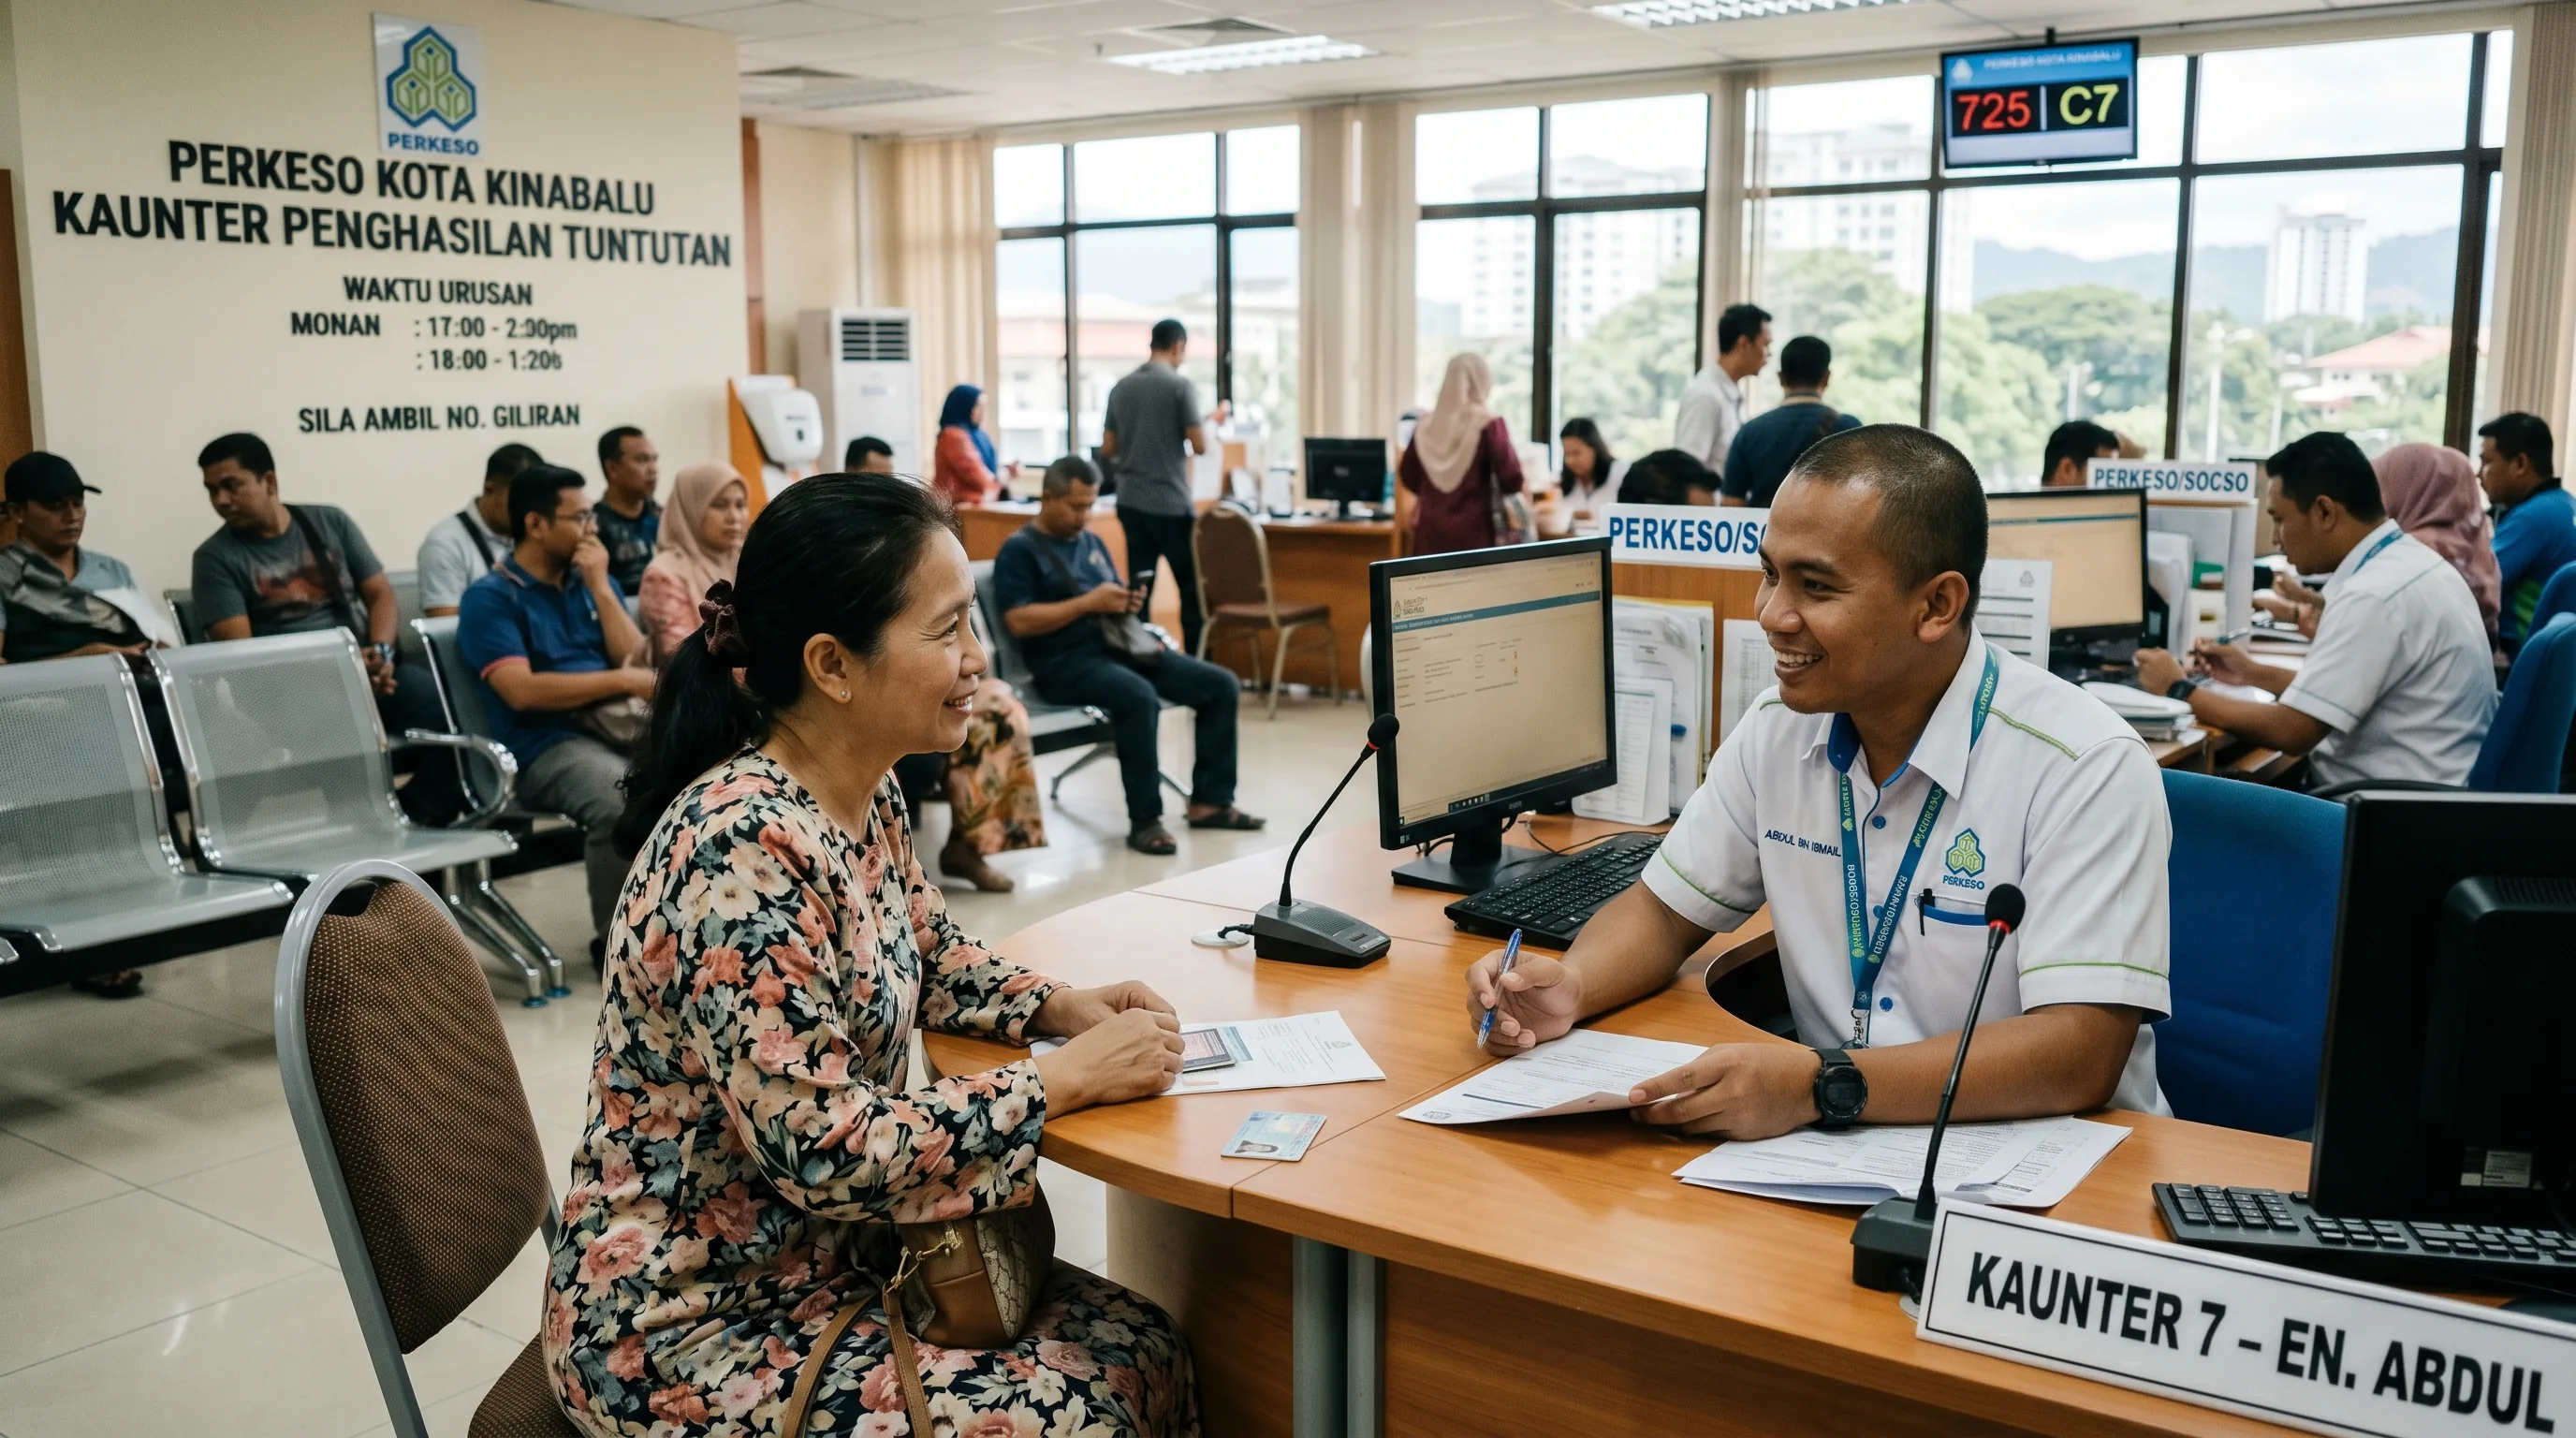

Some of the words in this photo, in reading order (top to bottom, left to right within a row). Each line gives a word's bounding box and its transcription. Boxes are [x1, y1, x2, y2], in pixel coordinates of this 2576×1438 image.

[1957, 90, 2032, 131] 725
[2059, 83, 2119, 125] C7
[388, 132, 479, 155] PERKESO
[168, 140, 364, 195] PERKESO
[376, 159, 476, 203] KOTA
[486, 169, 654, 215] KINABALU
[52, 191, 271, 244] KAUNTER
[283, 206, 552, 259] PENGHASILAN
[563, 224, 731, 267] TUNTUTAN
[343, 276, 432, 302] WAKTU
[439, 280, 533, 305] URUSAN
[291, 312, 381, 336] MONAN
[428, 316, 485, 338] 17:00
[431, 350, 487, 371] 18:00
[299, 408, 355, 433] SILA
[364, 407, 439, 432] AMBIL
[447, 405, 486, 429] NO.
[493, 404, 579, 427] GILIRAN
[2095, 468, 2248, 492] PERKESO/SOCSO
[1967, 1252, 2182, 1350] KAUNTER
[2199, 1299, 2226, 1357] 7
[2276, 1317, 2356, 1389] EN.
[2373, 1340, 2554, 1434] ABDUL
